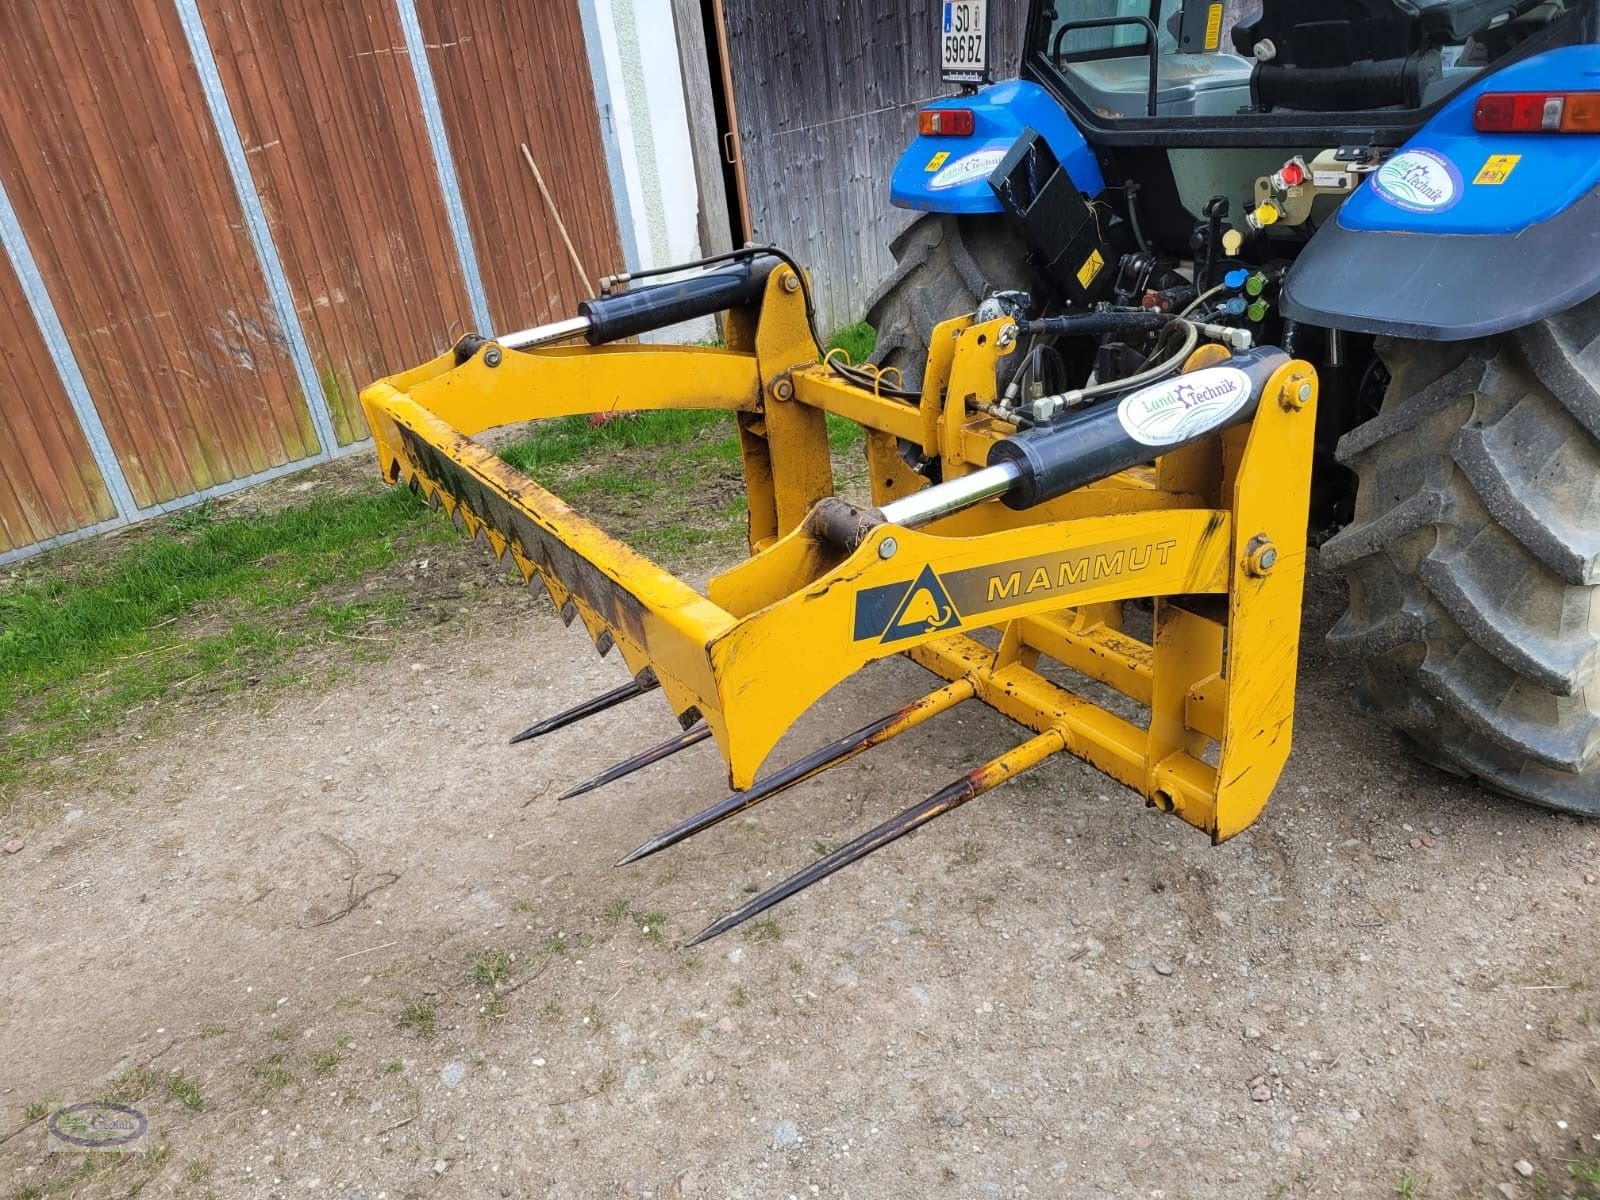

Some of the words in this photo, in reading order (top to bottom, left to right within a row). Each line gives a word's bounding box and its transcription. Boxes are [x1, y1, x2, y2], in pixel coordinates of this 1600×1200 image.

[955, 4, 970, 32] SD
[945, 35, 966, 63] 596
[967, 35, 982, 63] BZ
[1406, 172, 1443, 203] Technik
[1142, 391, 1176, 414] Land
[1187, 379, 1237, 407] Technik
[987, 540, 1177, 602] MAMMUT
